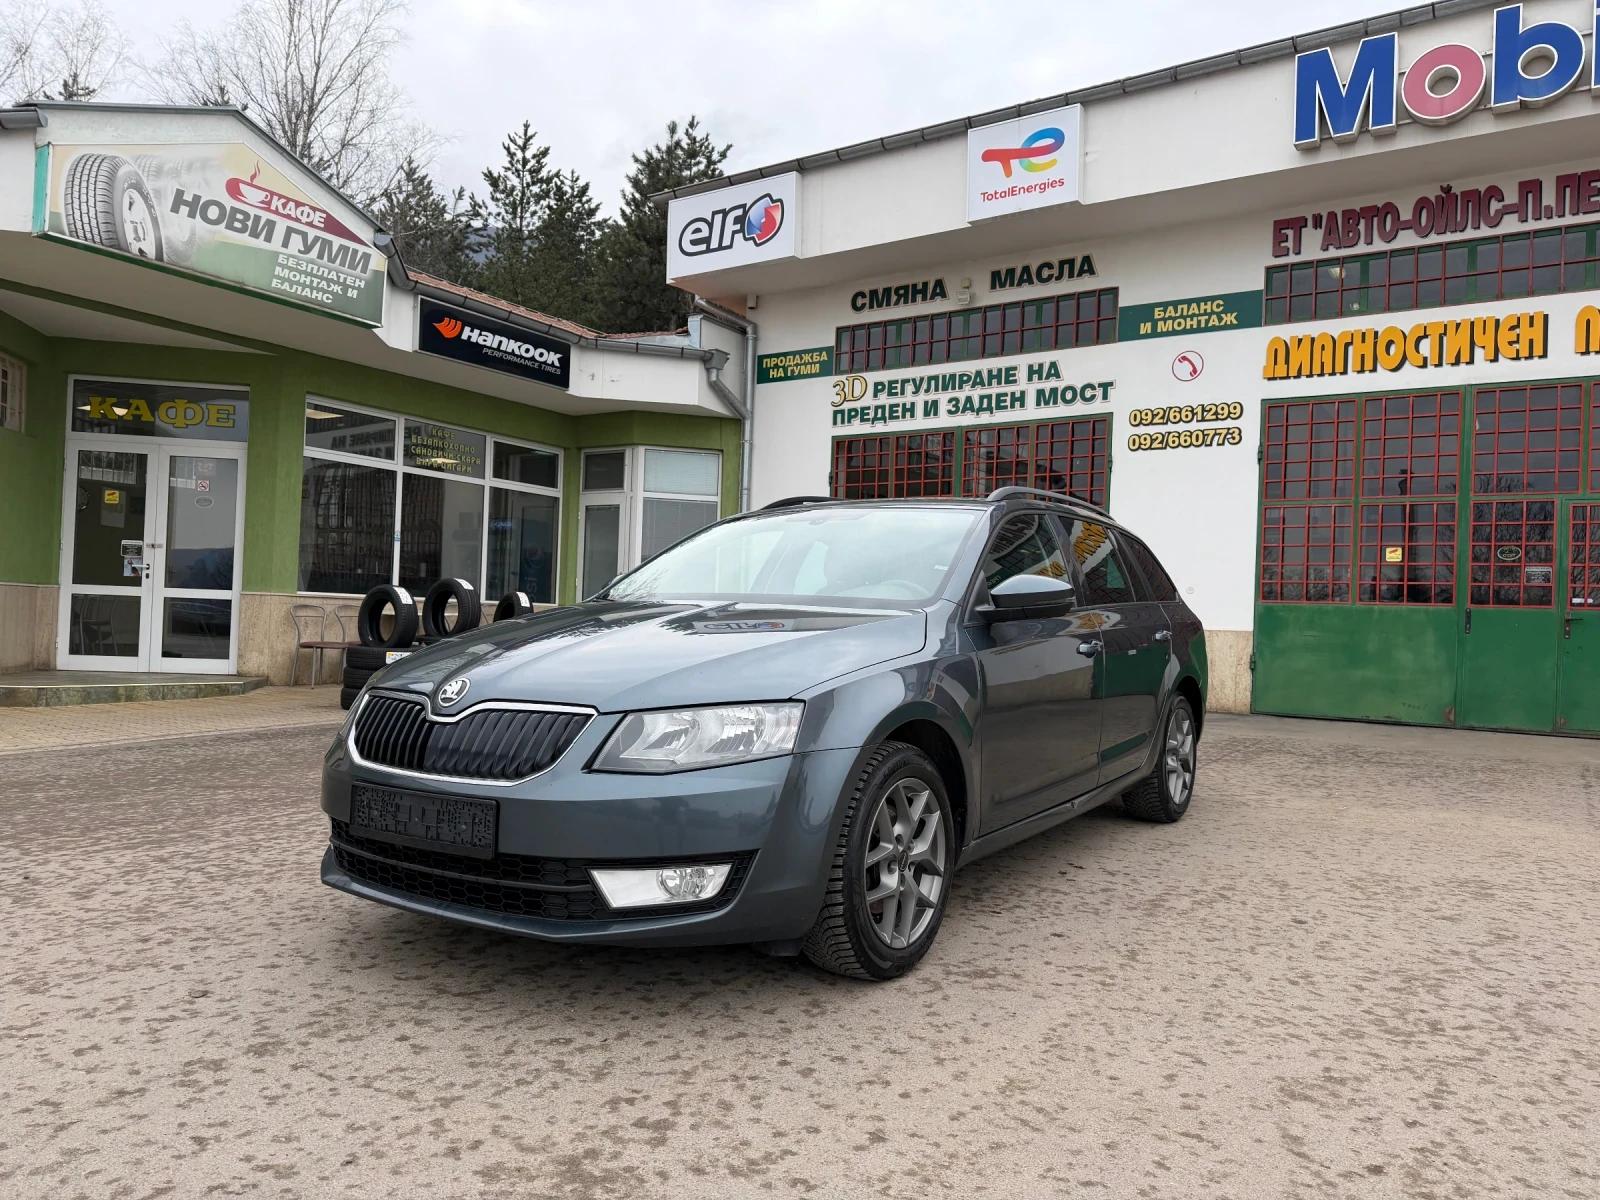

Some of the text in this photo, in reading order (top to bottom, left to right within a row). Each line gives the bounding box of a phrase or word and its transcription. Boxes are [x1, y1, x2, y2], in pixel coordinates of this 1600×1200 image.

[980, 178, 1065, 202] TotalEnergies
[270, 195, 327, 228] КАФЕ
[169, 188, 277, 243] НОВИ
[281, 225, 372, 275] ГУМИ
[678, 203, 748, 257] elf
[1272, 215, 1307, 257] ЕТ
[274, 266, 358, 299] МОНТАЖ И
[277, 254, 366, 289] БЕЗПЛАТЕН
[850, 253, 1099, 313] СМЯНА МАСЛА
[271, 278, 333, 303] БАЛАНС
[1139, 312, 1238, 334] И МОНТАЖ
[1154, 299, 1224, 319] БАЛАНС
[482, 347, 562, 375] PERFORMANCE TIRES
[762, 351, 828, 369] ПРОДАЖБА
[1262, 311, 1548, 379] ДИАГНОСТИЧЕН
[769, 363, 820, 379] НА ГУМИ
[831, 360, 1063, 408] 3D РЕГУЛИРАНЕ НА
[88, 396, 236, 428] КАФЕ
[832, 380, 1115, 428] ПРЕДЕН И ЗАДЕН МОСТ
[1129, 402, 1243, 427] 092/661299
[432, 428, 455, 439] КАФЕ
[1128, 427, 1242, 451] 092/660773
